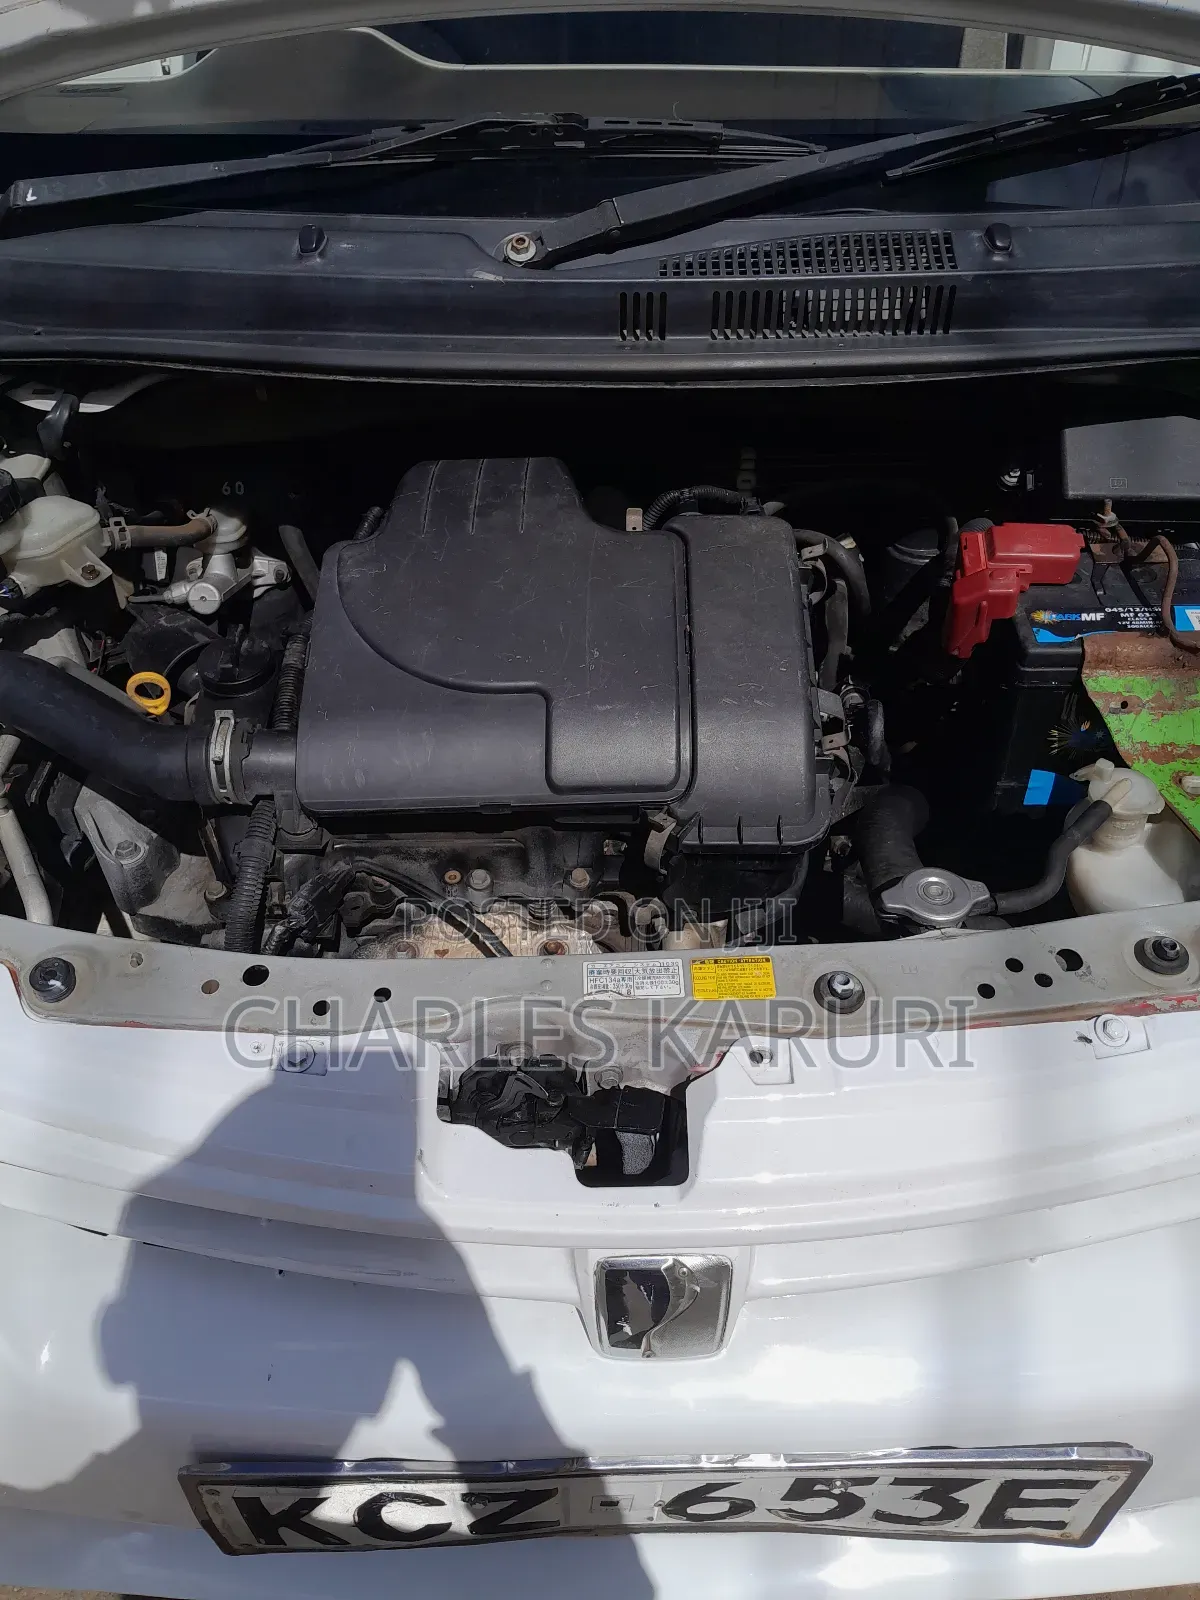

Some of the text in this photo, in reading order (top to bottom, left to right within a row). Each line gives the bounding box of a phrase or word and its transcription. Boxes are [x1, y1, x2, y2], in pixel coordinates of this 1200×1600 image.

[222, 481, 244, 496] 60
[232, 1476, 1102, 1547] KCZ 653E
